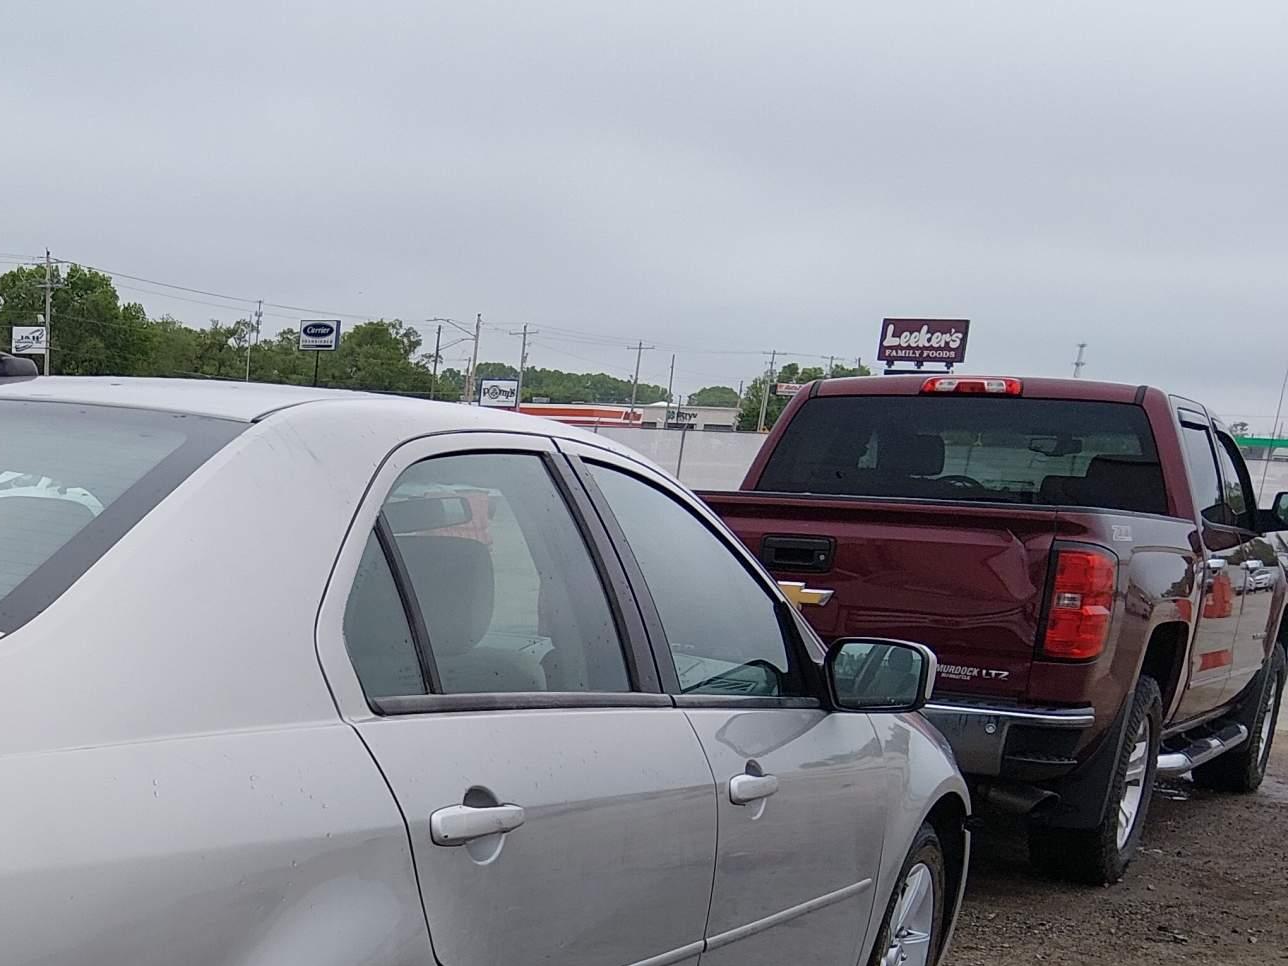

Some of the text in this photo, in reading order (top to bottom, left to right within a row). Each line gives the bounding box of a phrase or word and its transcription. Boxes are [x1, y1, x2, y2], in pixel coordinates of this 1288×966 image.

[306, 327, 331, 335] Carrier
[882, 323, 963, 349] Leeker's
[885, 349, 956, 358] FAMILY FOODS
[936, 663, 980, 677] MURDOCK
[982, 669, 1010, 681] LTZ
